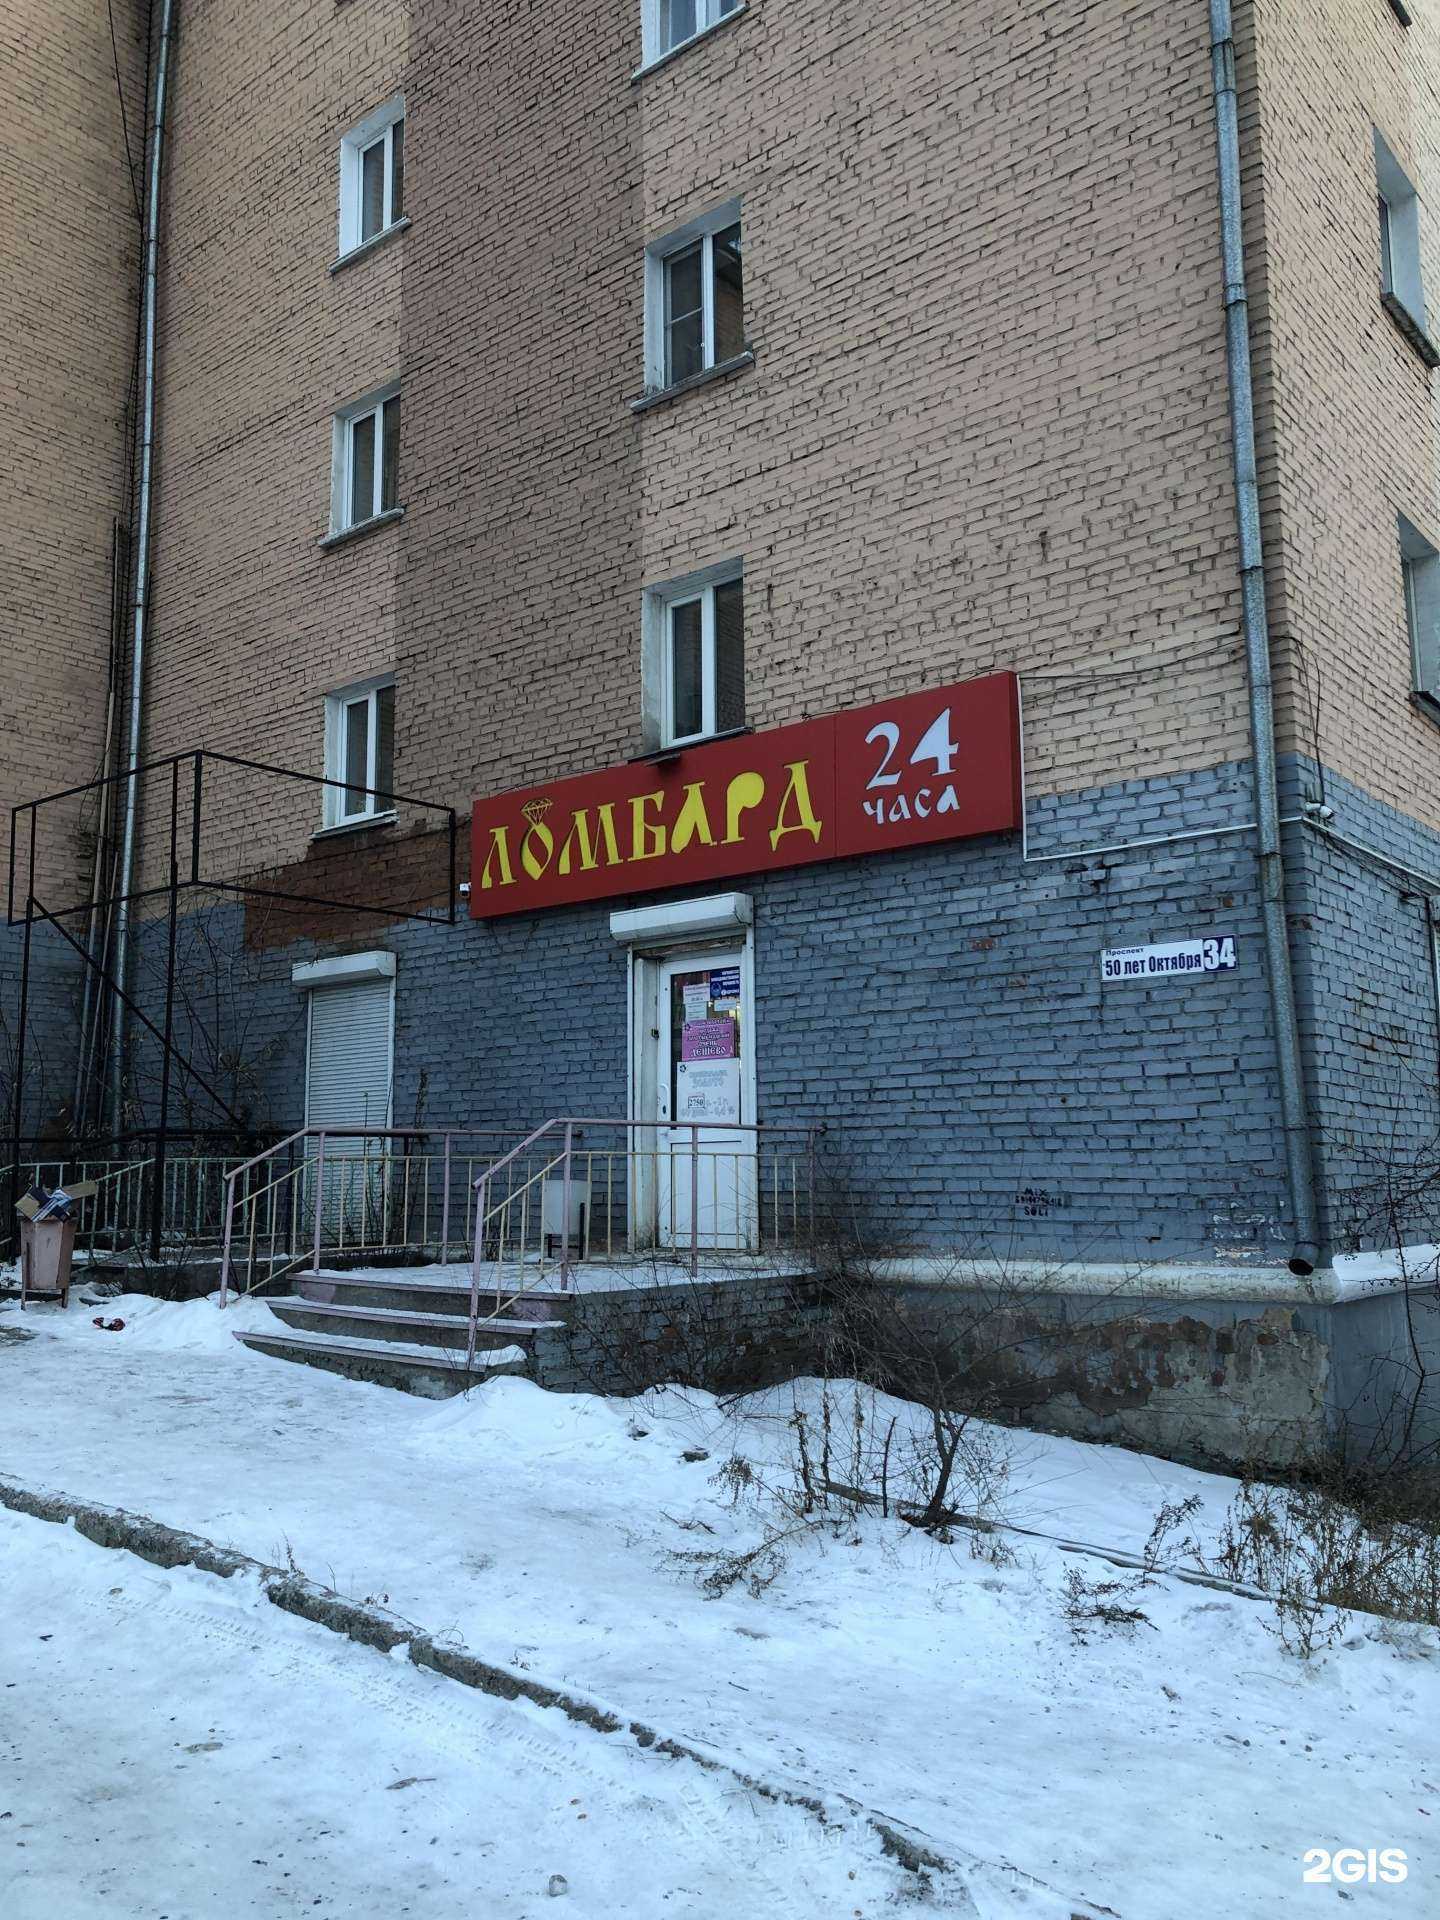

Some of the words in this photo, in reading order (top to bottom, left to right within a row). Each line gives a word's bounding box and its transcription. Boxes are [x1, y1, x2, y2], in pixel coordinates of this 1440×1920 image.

[865, 707, 959, 790] 24
[481, 760, 822, 889] ЛОМБАРД
[1105, 947, 1144, 957] Проспект
[1105, 959, 1121, 976] 50
[1124, 959, 1146, 975] лет
[1148, 953, 1202, 972] Октября
[1203, 937, 1237, 970] 34
